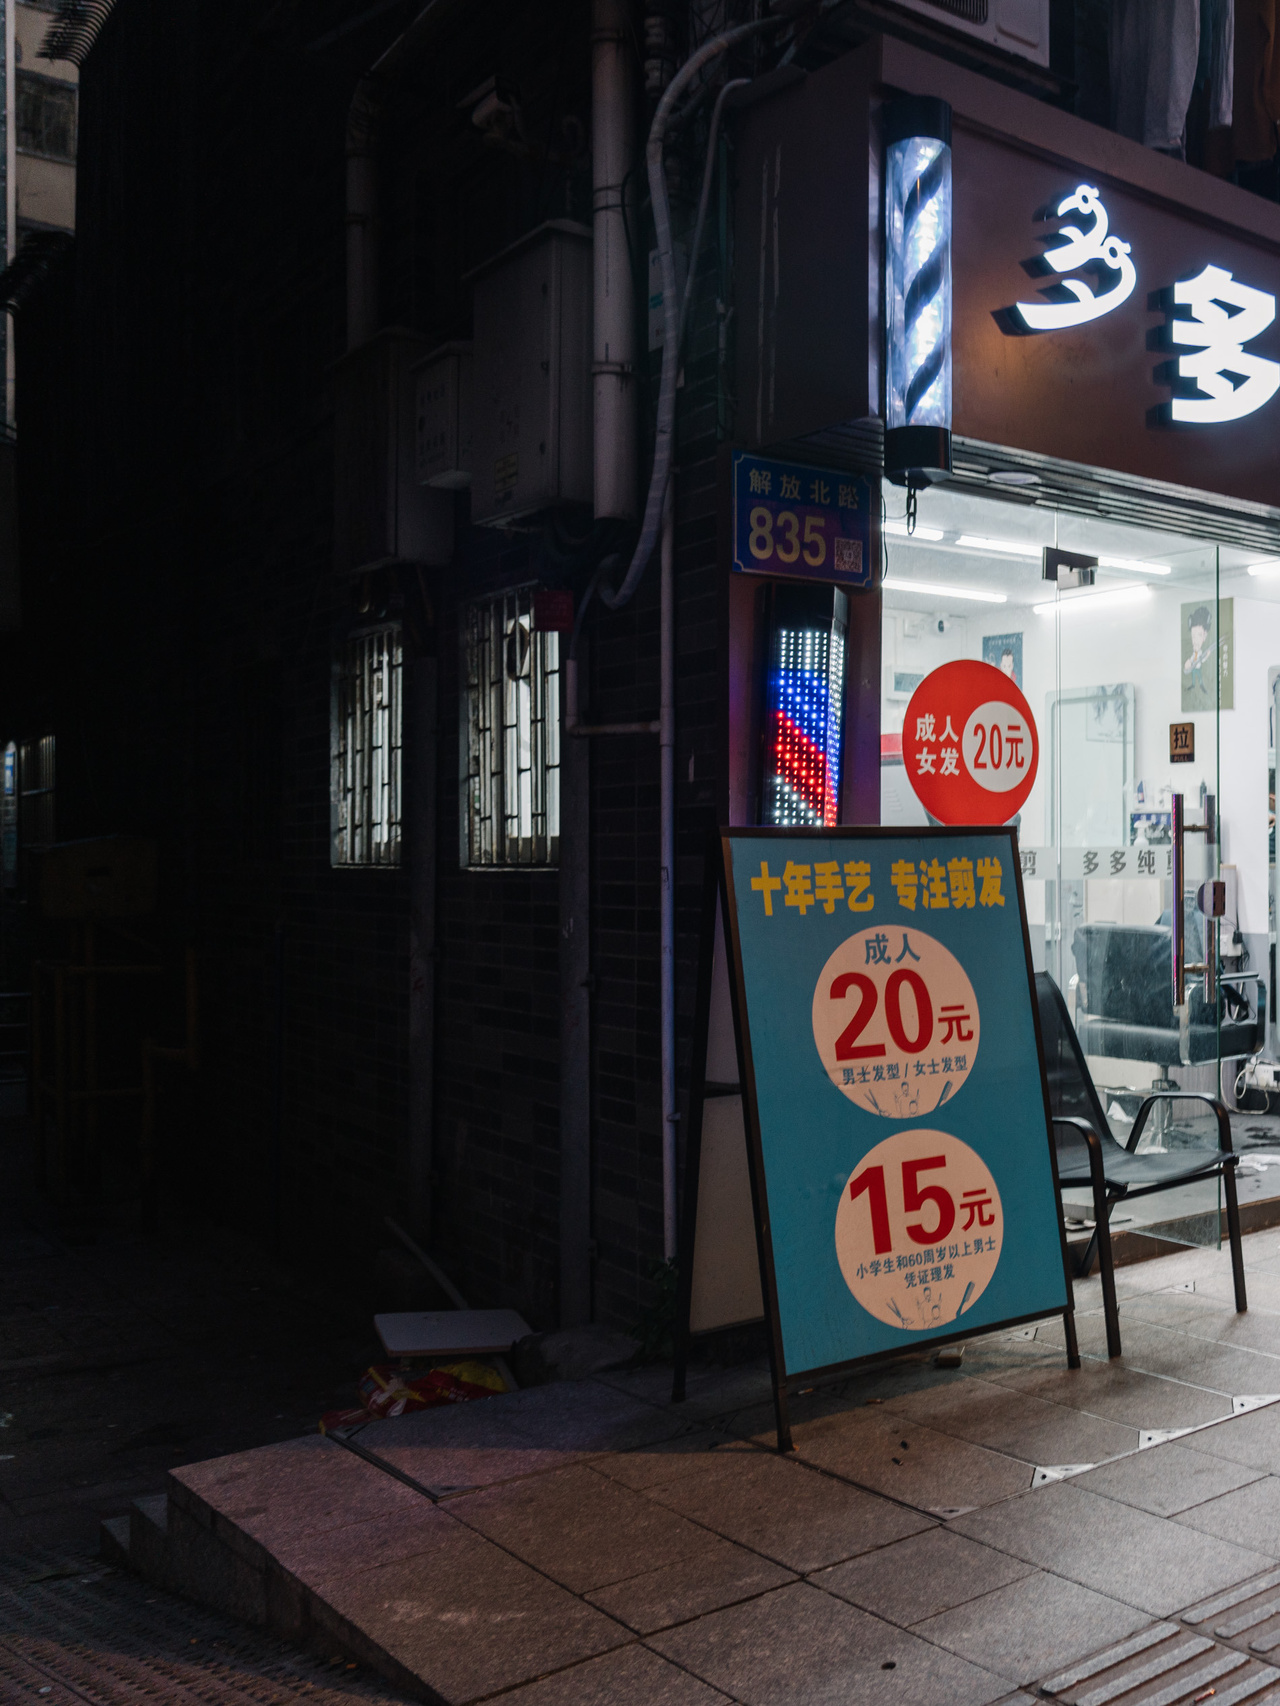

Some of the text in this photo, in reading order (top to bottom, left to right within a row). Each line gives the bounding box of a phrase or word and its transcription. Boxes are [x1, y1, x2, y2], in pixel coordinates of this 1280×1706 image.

[749, 467, 860, 511] 解放北路
[749, 506, 827, 567] 835
[915, 713, 1025, 770] 成人 20元
[1173, 727, 1190, 750] 拉
[915, 747, 960, 776] 女发
[1083, 850, 1172, 876] 多多纯
[751, 857, 1005, 916] 十年手艺 专注剪发
[865, 933, 921, 965] 成人
[829, 968, 974, 1062] 20元
[842, 1062, 900, 1086] 男士发型
[912, 1054, 968, 1077] 女士发型
[849, 1154, 995, 1256] 15元
[856, 1236, 996, 1280] 小学生和60周岁以上男士
[904, 1264, 955, 1289] 凭证理发
